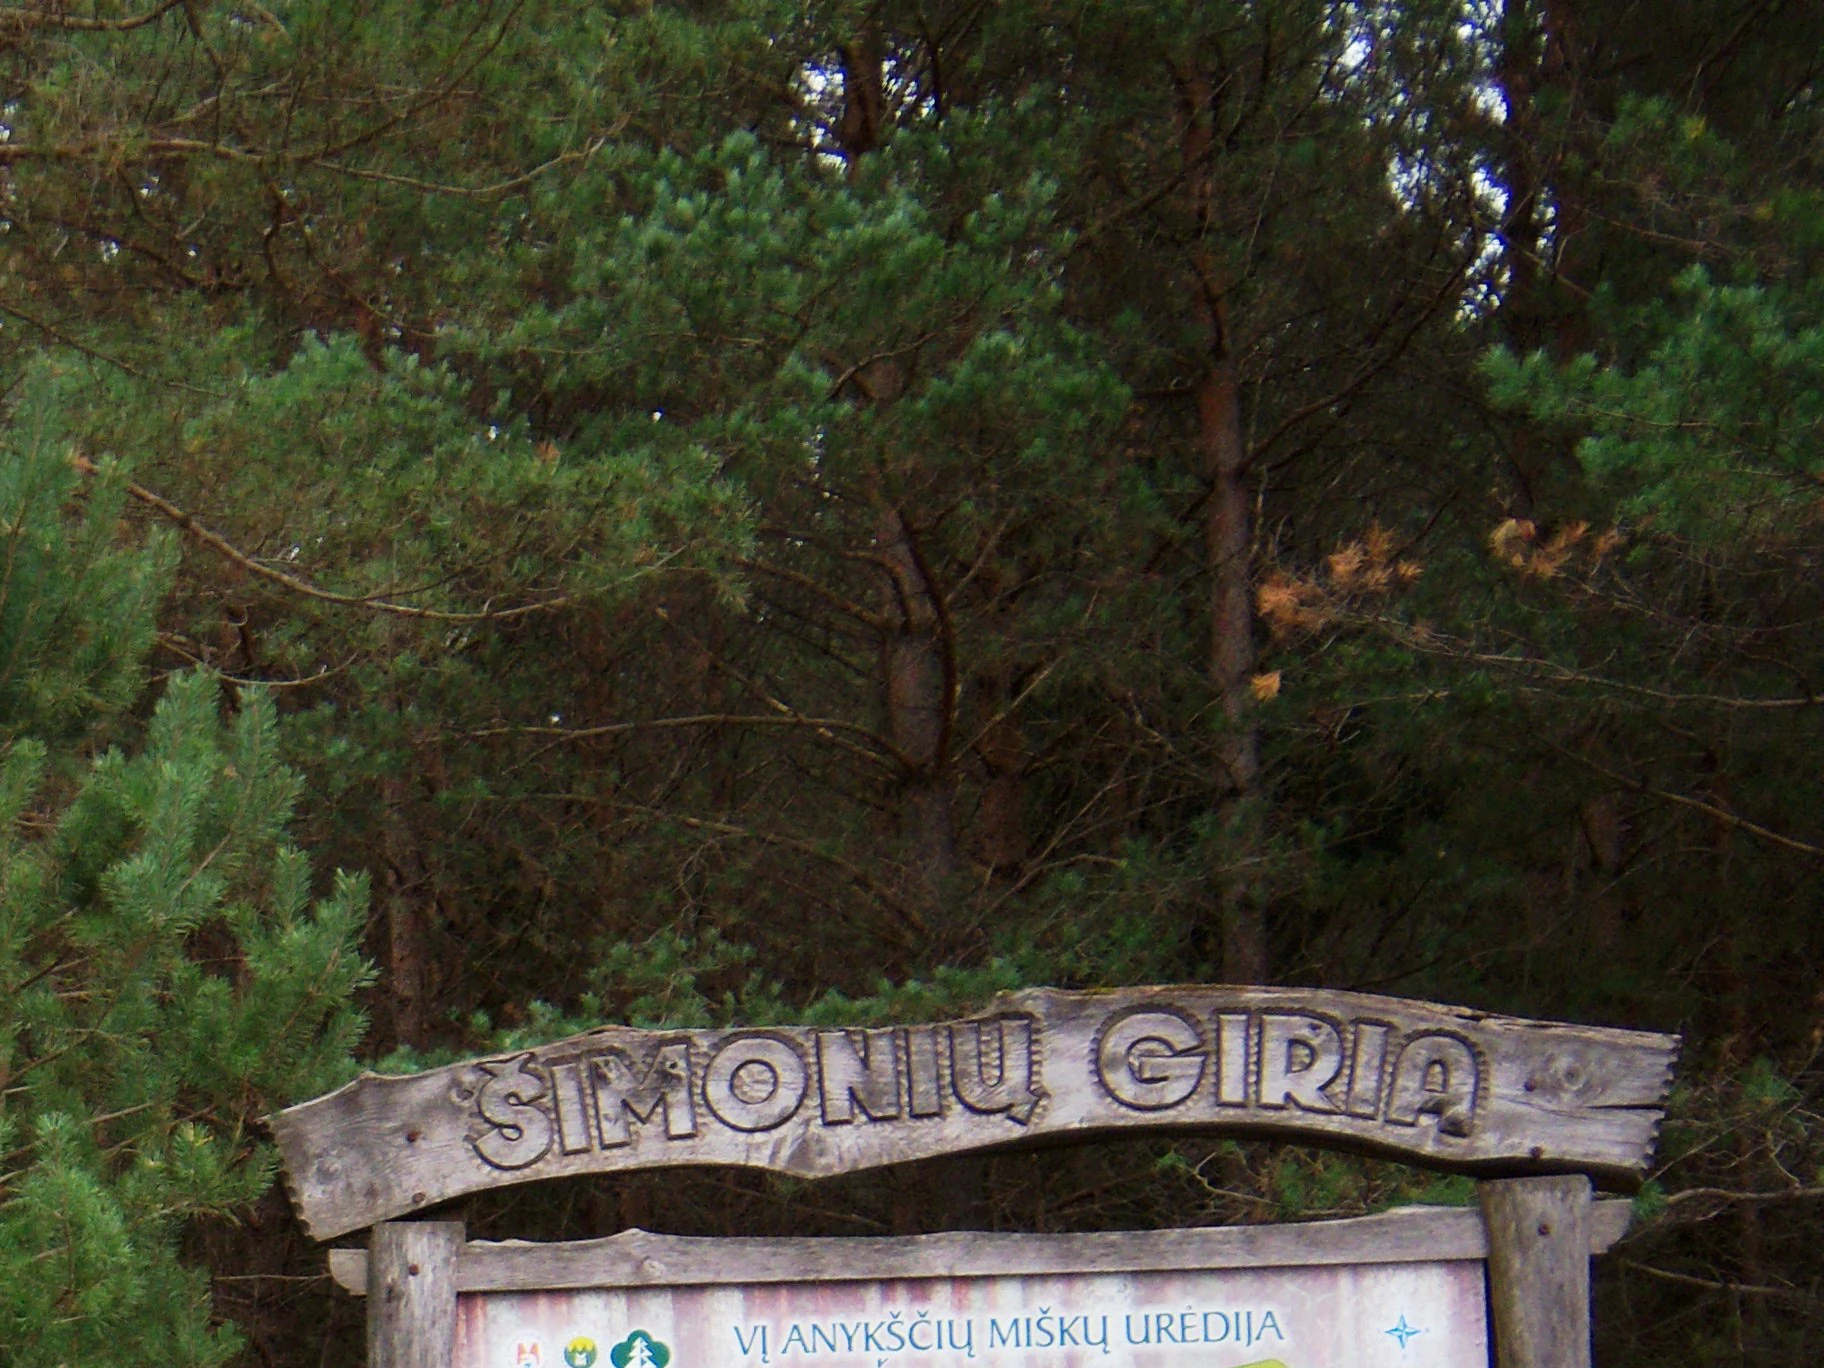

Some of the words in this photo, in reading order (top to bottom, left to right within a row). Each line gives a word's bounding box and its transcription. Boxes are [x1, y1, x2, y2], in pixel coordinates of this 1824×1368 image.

[473, 1013, 1049, 1170] ŠIMONIŲ
[1094, 1004, 1482, 1137] GIRIA
[732, 1325, 771, 1364] VĮ
[781, 1310, 975, 1359] ANYKŠČIŲ
[988, 1306, 1110, 1354] MIŠKŲ
[1124, 1304, 1286, 1349] URĖDIJA
